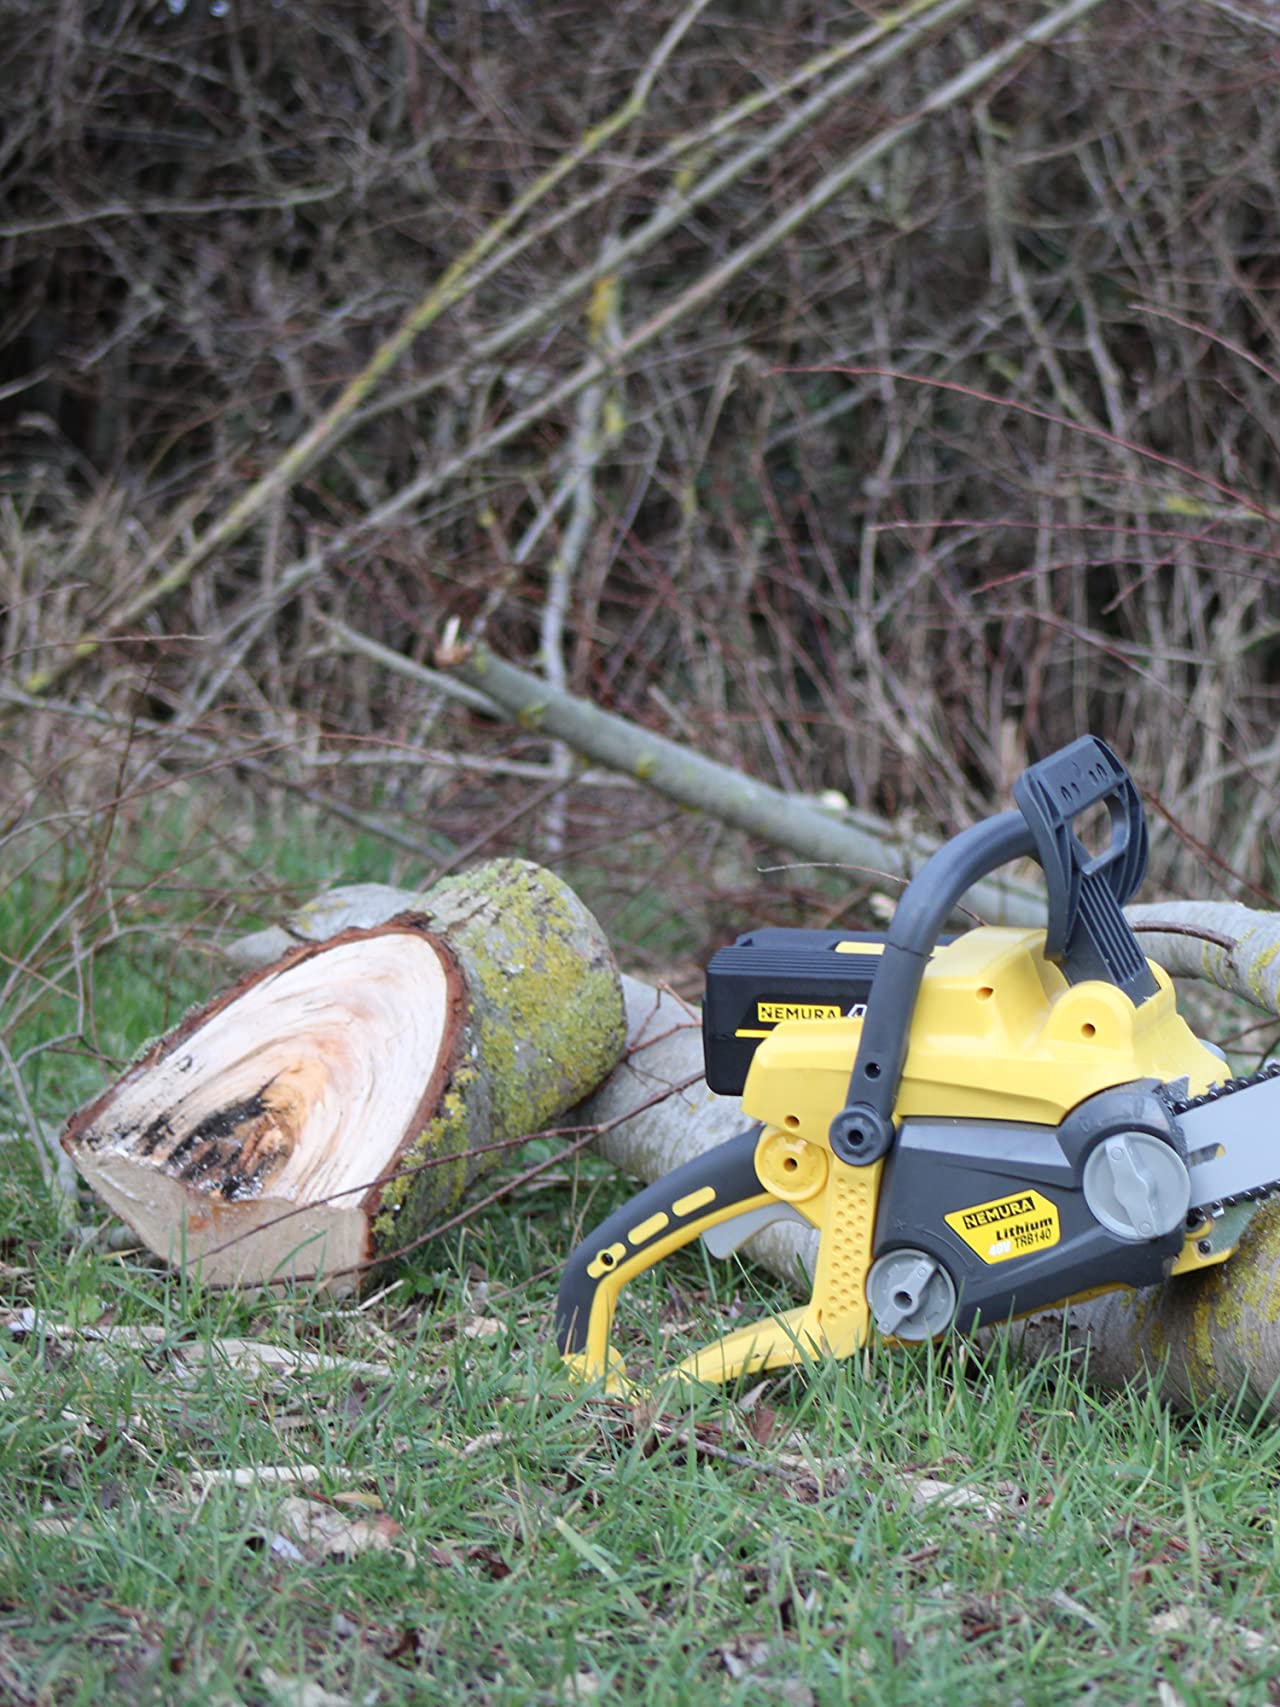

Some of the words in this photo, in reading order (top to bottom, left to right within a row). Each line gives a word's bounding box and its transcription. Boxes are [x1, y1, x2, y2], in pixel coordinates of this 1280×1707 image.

[760, 1006, 837, 1020] NEMURA
[963, 1197, 1035, 1230] NEMURA
[996, 1218, 1053, 1241] Lithium
